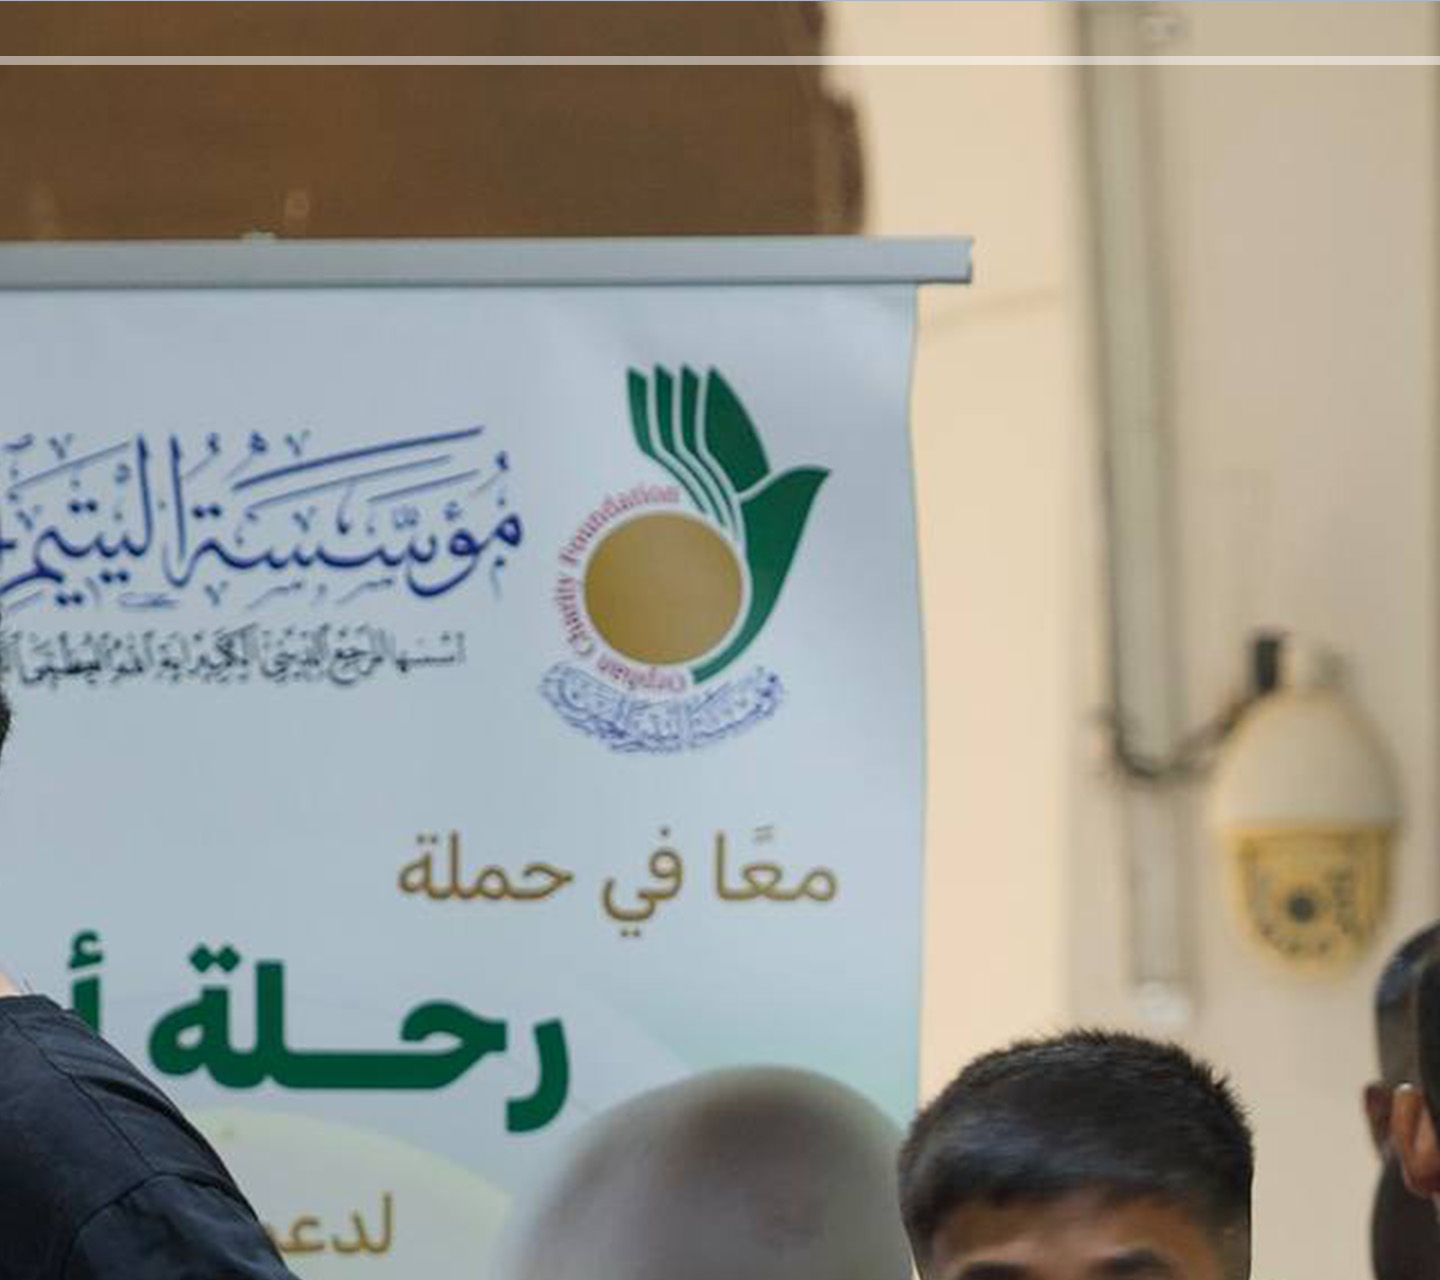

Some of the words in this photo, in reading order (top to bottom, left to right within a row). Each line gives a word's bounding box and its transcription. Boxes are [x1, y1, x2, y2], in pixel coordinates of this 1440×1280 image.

[398, 831, 574, 901] حملة
[601, 828, 683, 937] في
[263, 1190, 395, 1258] لدع
